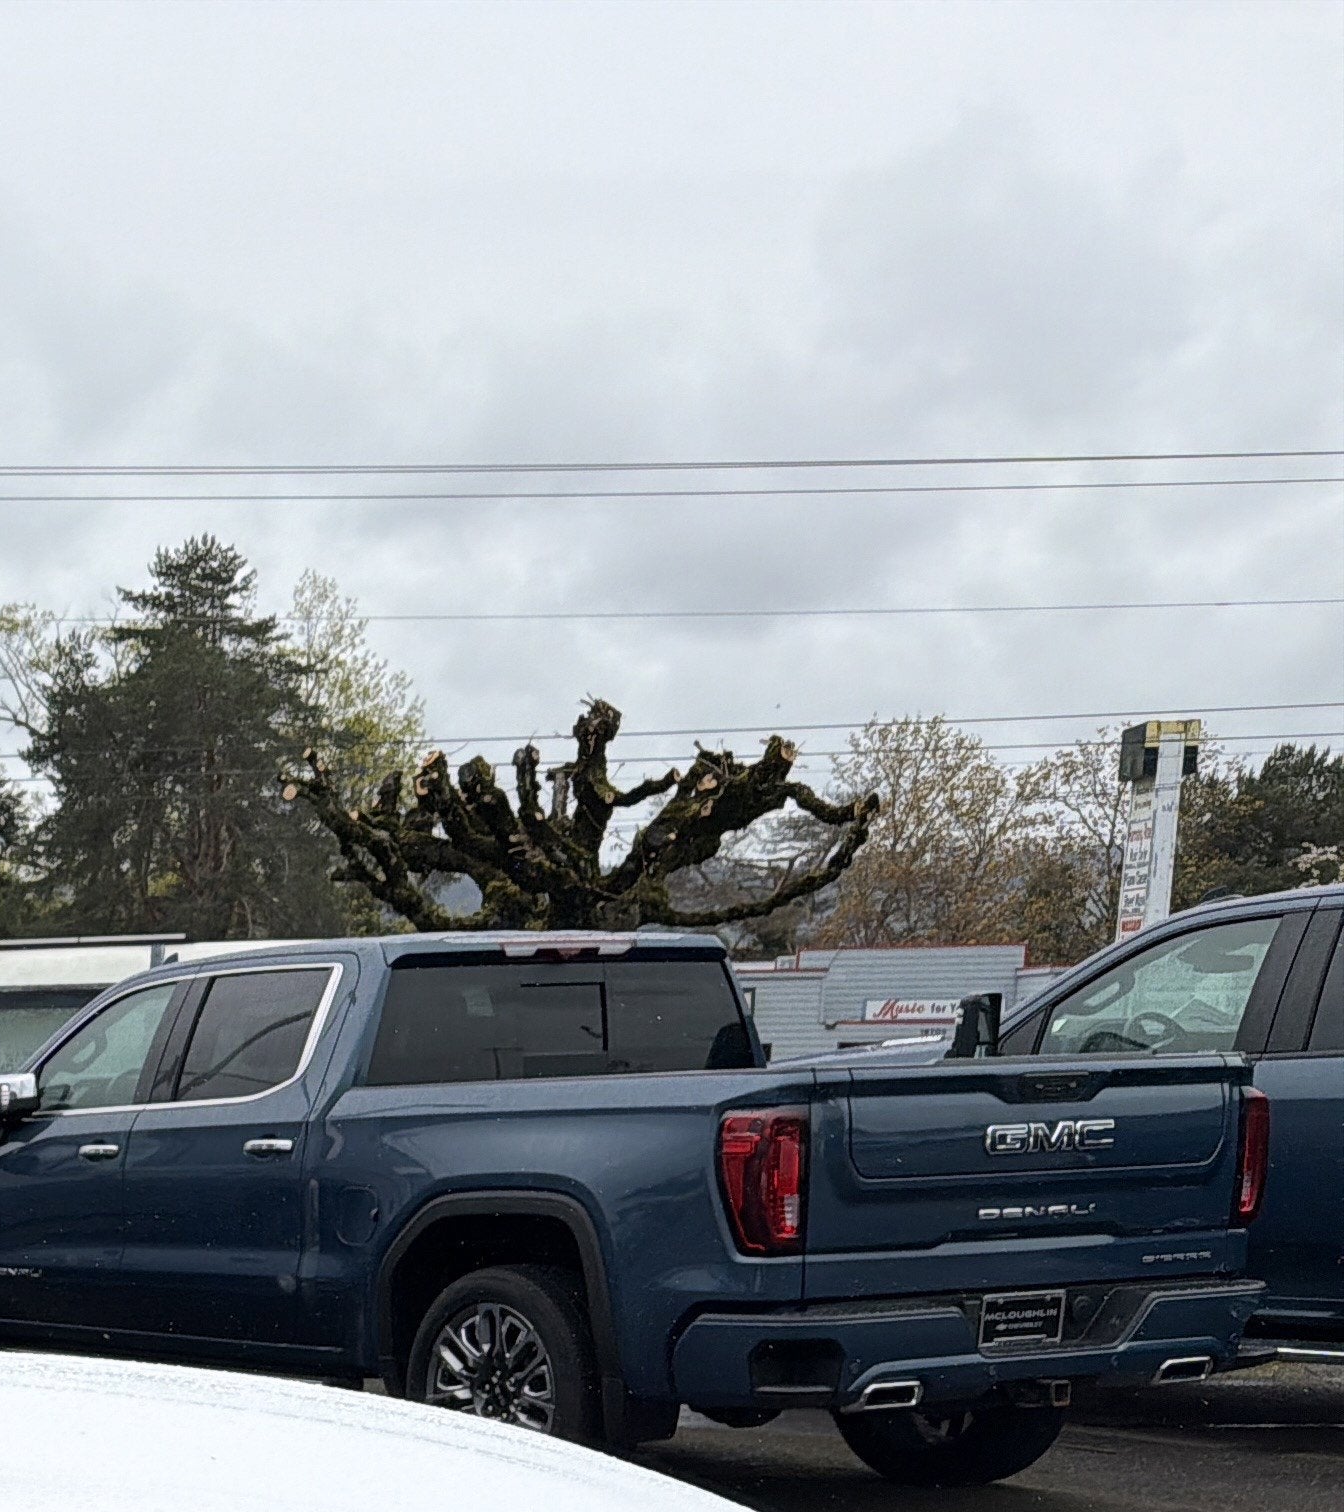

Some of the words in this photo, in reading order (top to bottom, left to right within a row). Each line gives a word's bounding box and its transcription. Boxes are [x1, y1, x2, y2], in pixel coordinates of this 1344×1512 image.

[873, 998, 925, 1019] Music
[930, 1003, 947, 1013] for
[985, 1119, 1115, 1155] GMC
[978, 1202, 1096, 1219] DENALI
[1141, 1251, 1212, 1264] SIERRA
[984, 1307, 1058, 1321] MCLOUGHLIN
